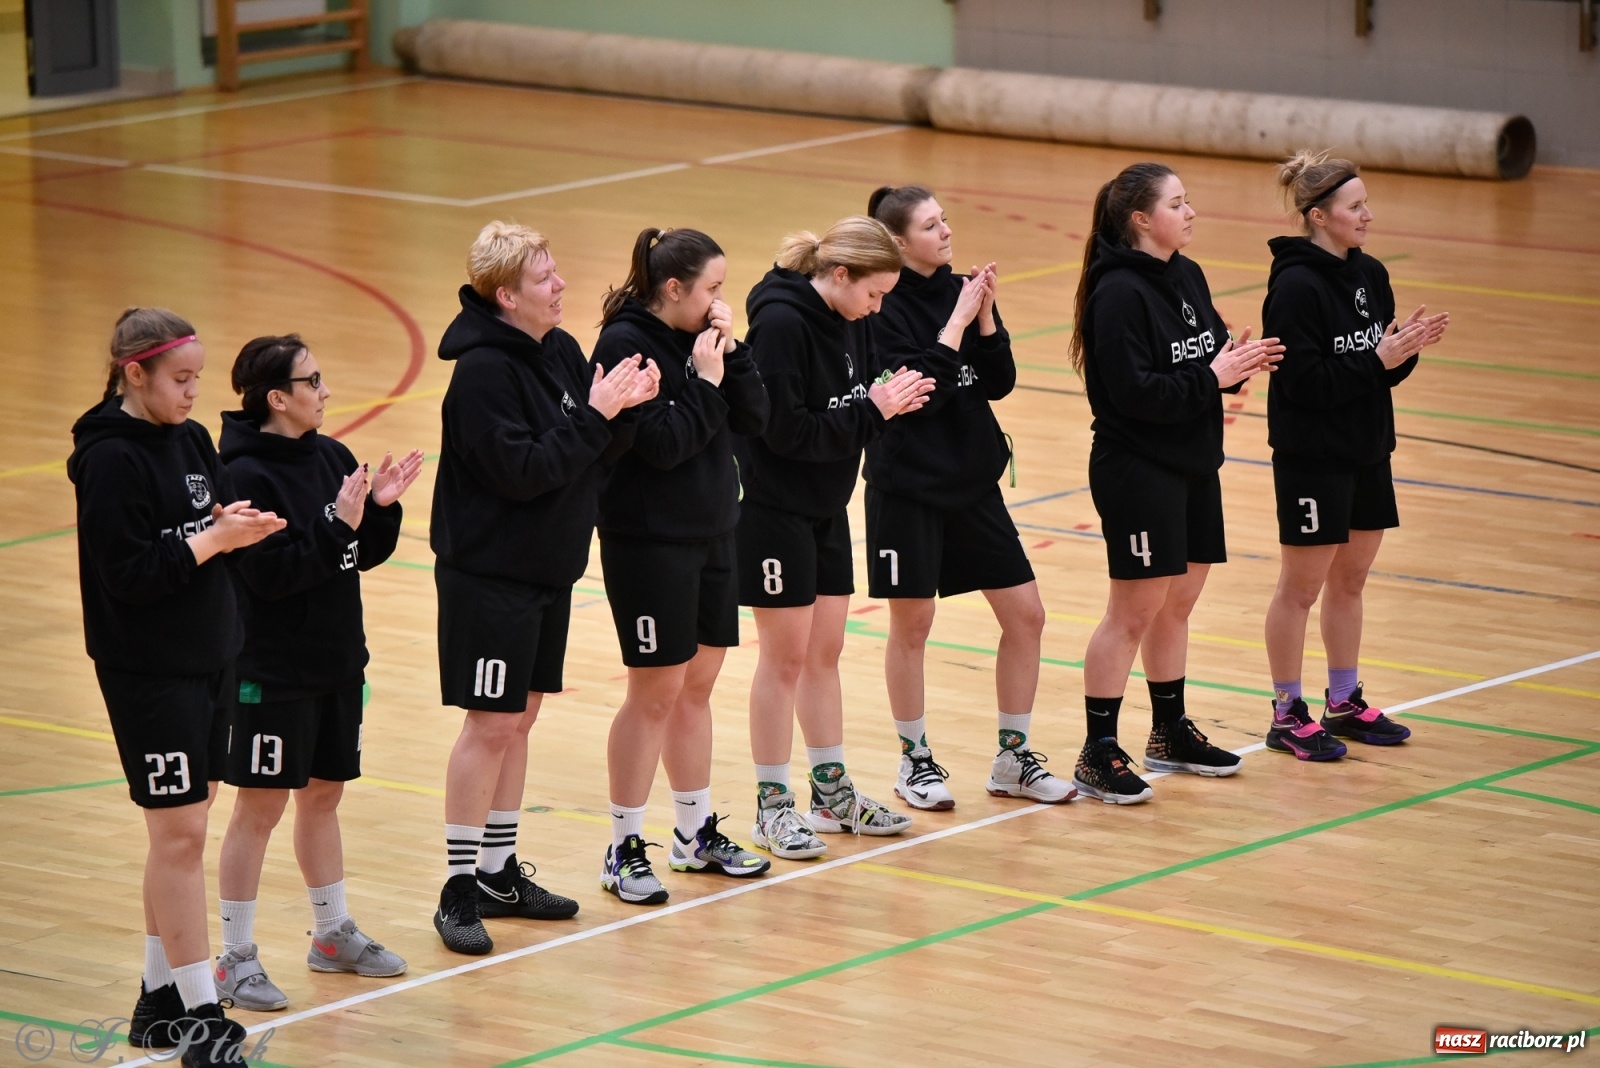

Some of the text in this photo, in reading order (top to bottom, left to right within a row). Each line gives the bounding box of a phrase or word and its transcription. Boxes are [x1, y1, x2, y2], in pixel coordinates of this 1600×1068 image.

[1298, 497, 1320, 534] 3
[879, 549, 899, 586] 7
[1129, 531, 1152, 567] 4
[761, 558, 784, 595] 8
[636, 615, 658, 654] 9
[473, 657, 507, 699] 10
[144, 751, 192, 796] 23
[250, 733, 283, 776] 13
